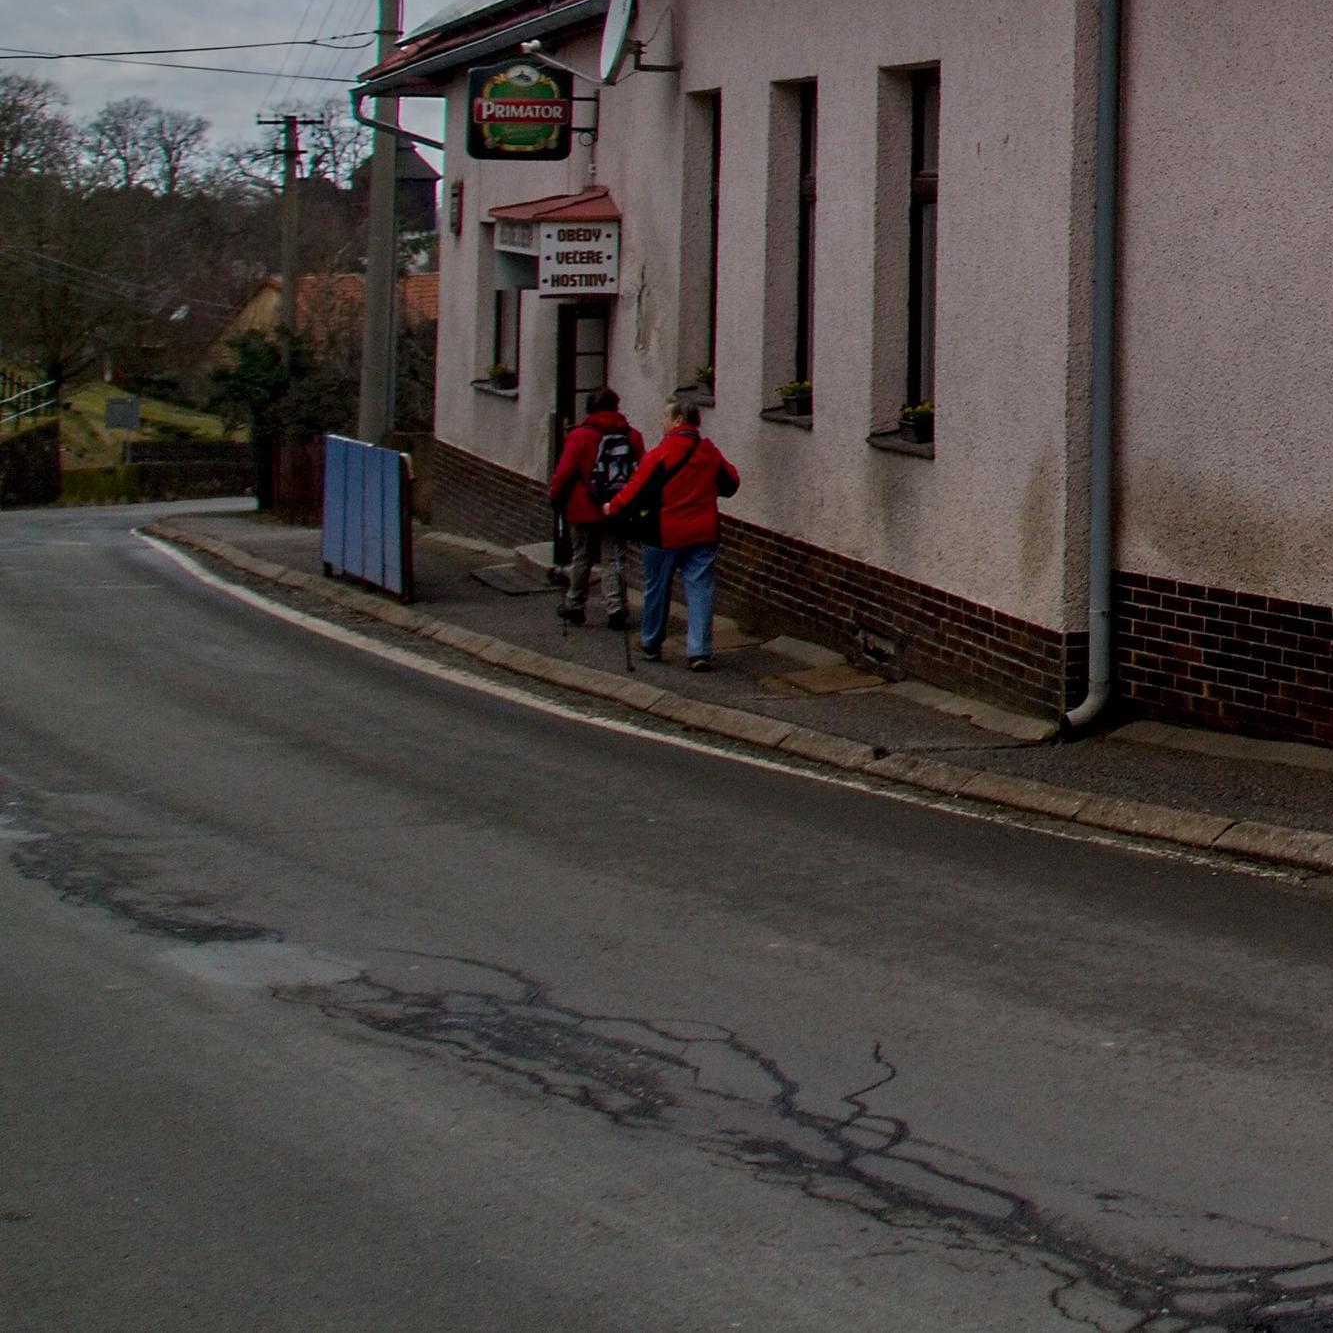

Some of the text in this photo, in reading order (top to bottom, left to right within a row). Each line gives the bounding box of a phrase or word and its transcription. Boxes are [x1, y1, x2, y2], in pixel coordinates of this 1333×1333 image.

[482, 101, 563, 119] PRIMATOR
[557, 227, 602, 242] OBĚDY
[551, 273, 607, 287] HOSTINY
